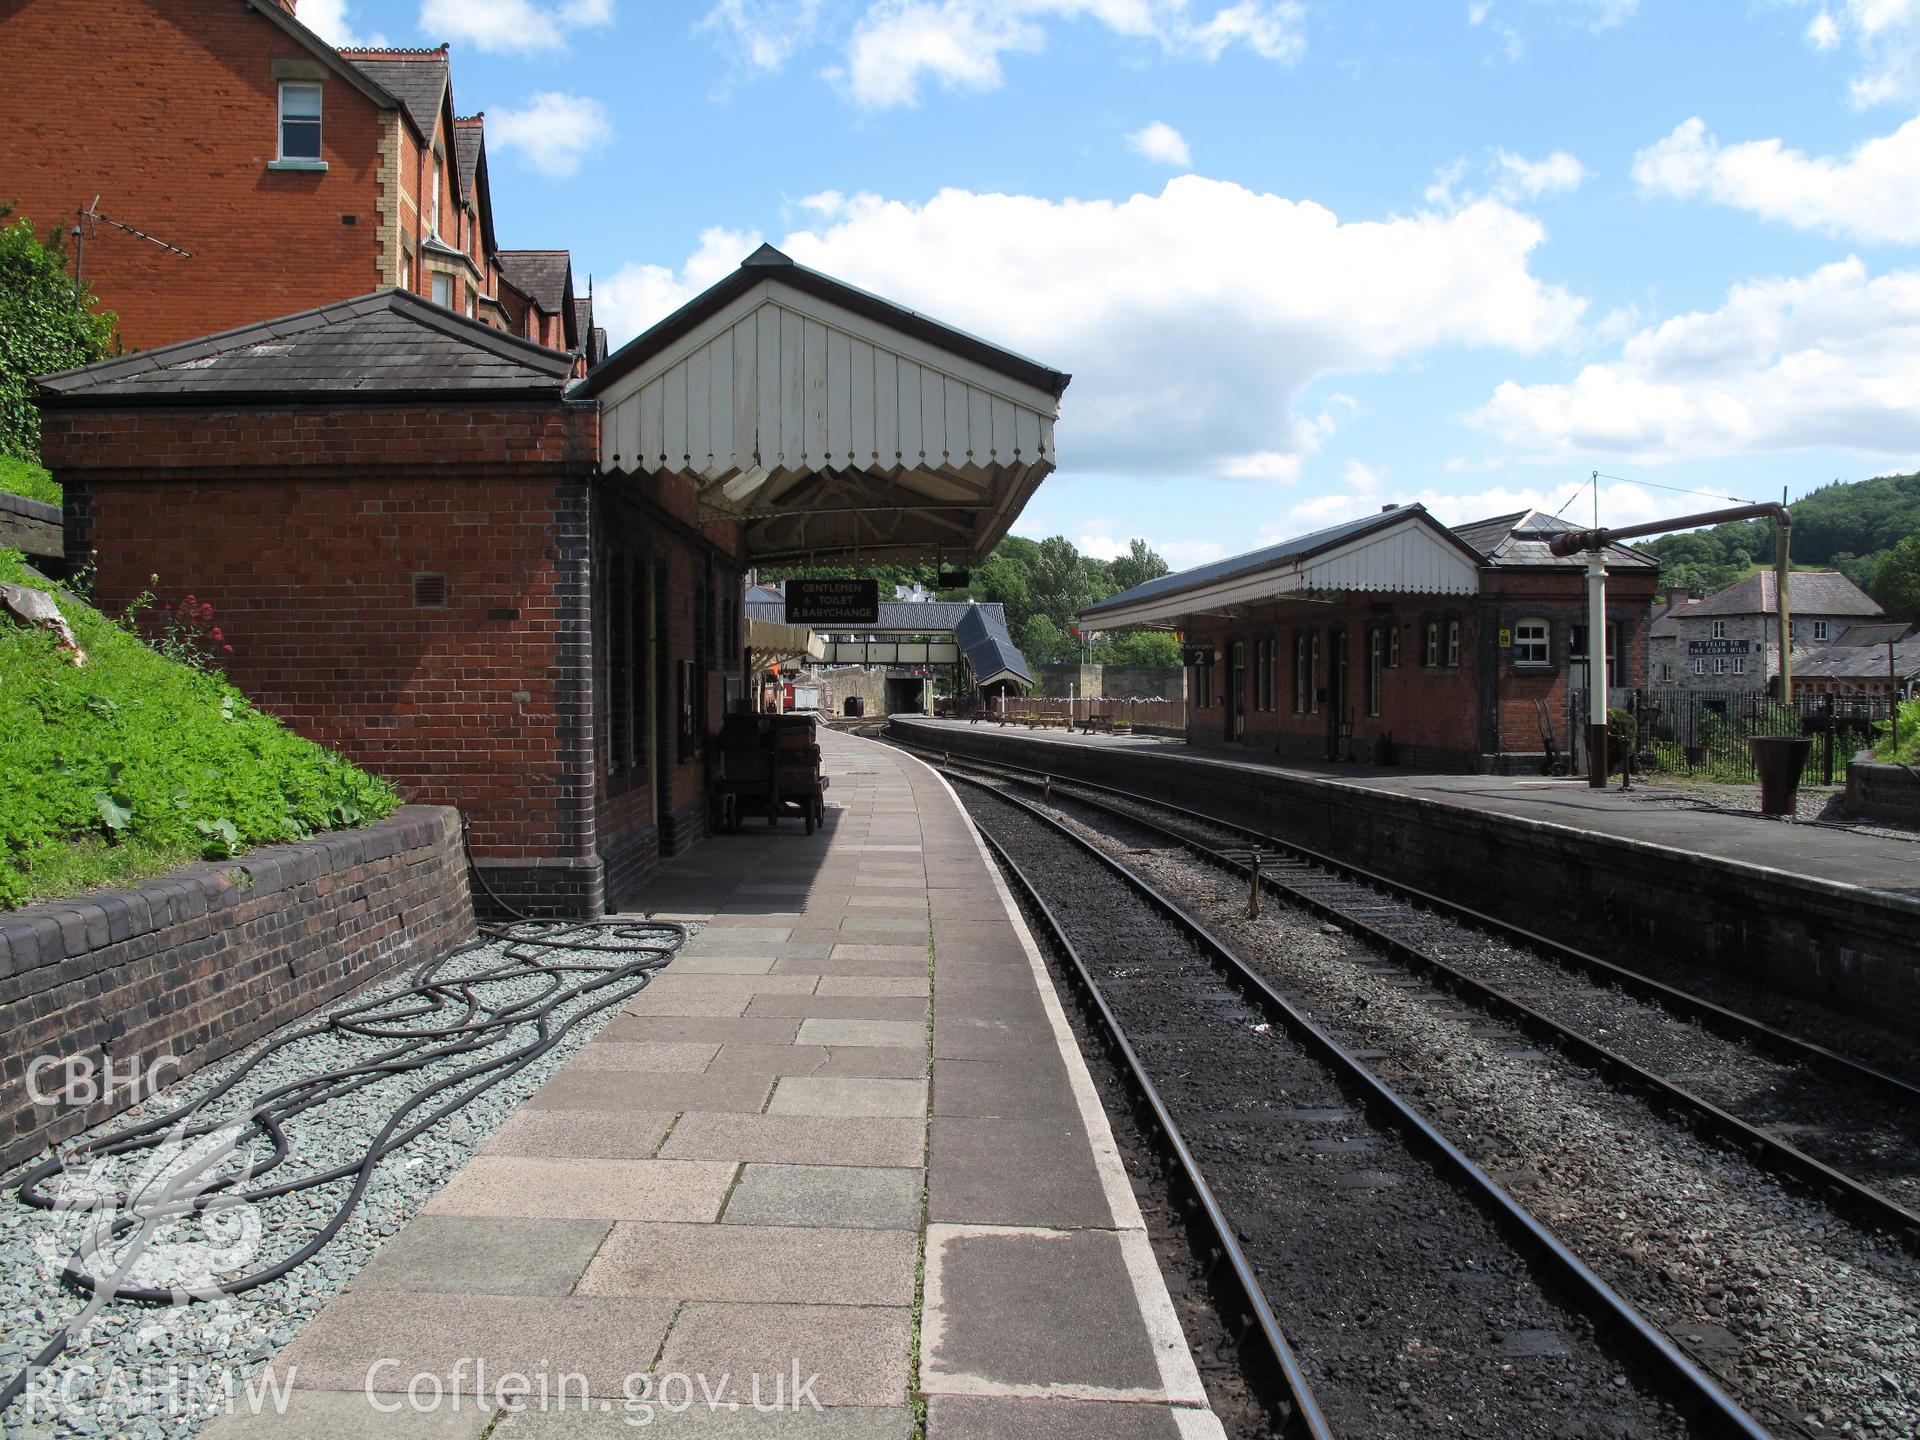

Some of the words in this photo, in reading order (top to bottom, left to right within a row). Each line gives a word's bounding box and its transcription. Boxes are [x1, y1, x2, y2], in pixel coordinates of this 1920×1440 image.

[802, 583, 862, 593] GENTLEMEN
[819, 595, 854, 605] TOILET
[802, 607, 872, 617] BABYCHANGE
[1194, 651, 1204, 664] 2
